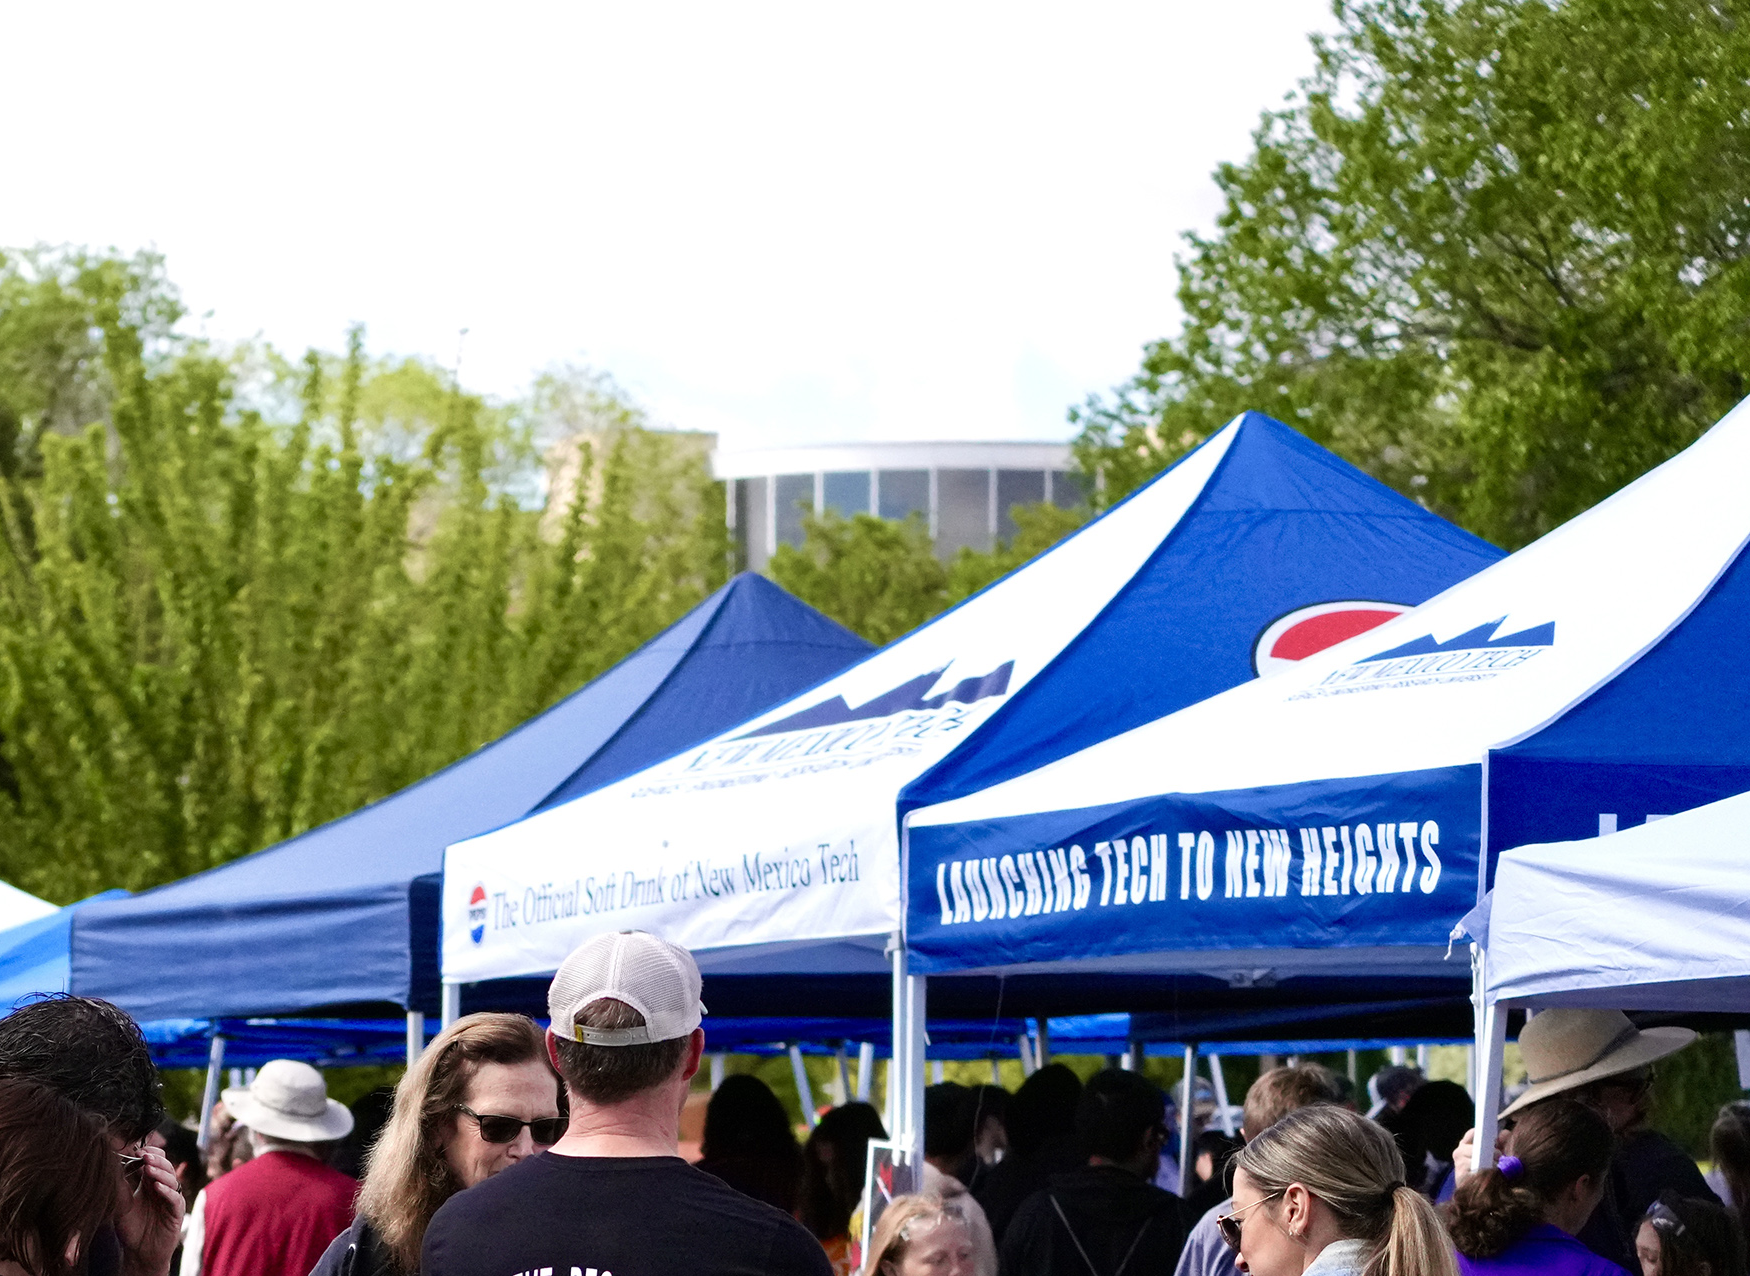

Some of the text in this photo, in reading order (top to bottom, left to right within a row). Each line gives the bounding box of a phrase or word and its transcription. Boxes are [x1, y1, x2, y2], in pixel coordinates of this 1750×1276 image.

[1371, 652, 1472, 678] MEXICO
[1460, 648, 1546, 668] TECH
[492, 839, 860, 931] The Official Soft Drink of New Mexico Tech
[936, 819, 1443, 926] LAUNCHING TECH TO NEW HEIGHTS
